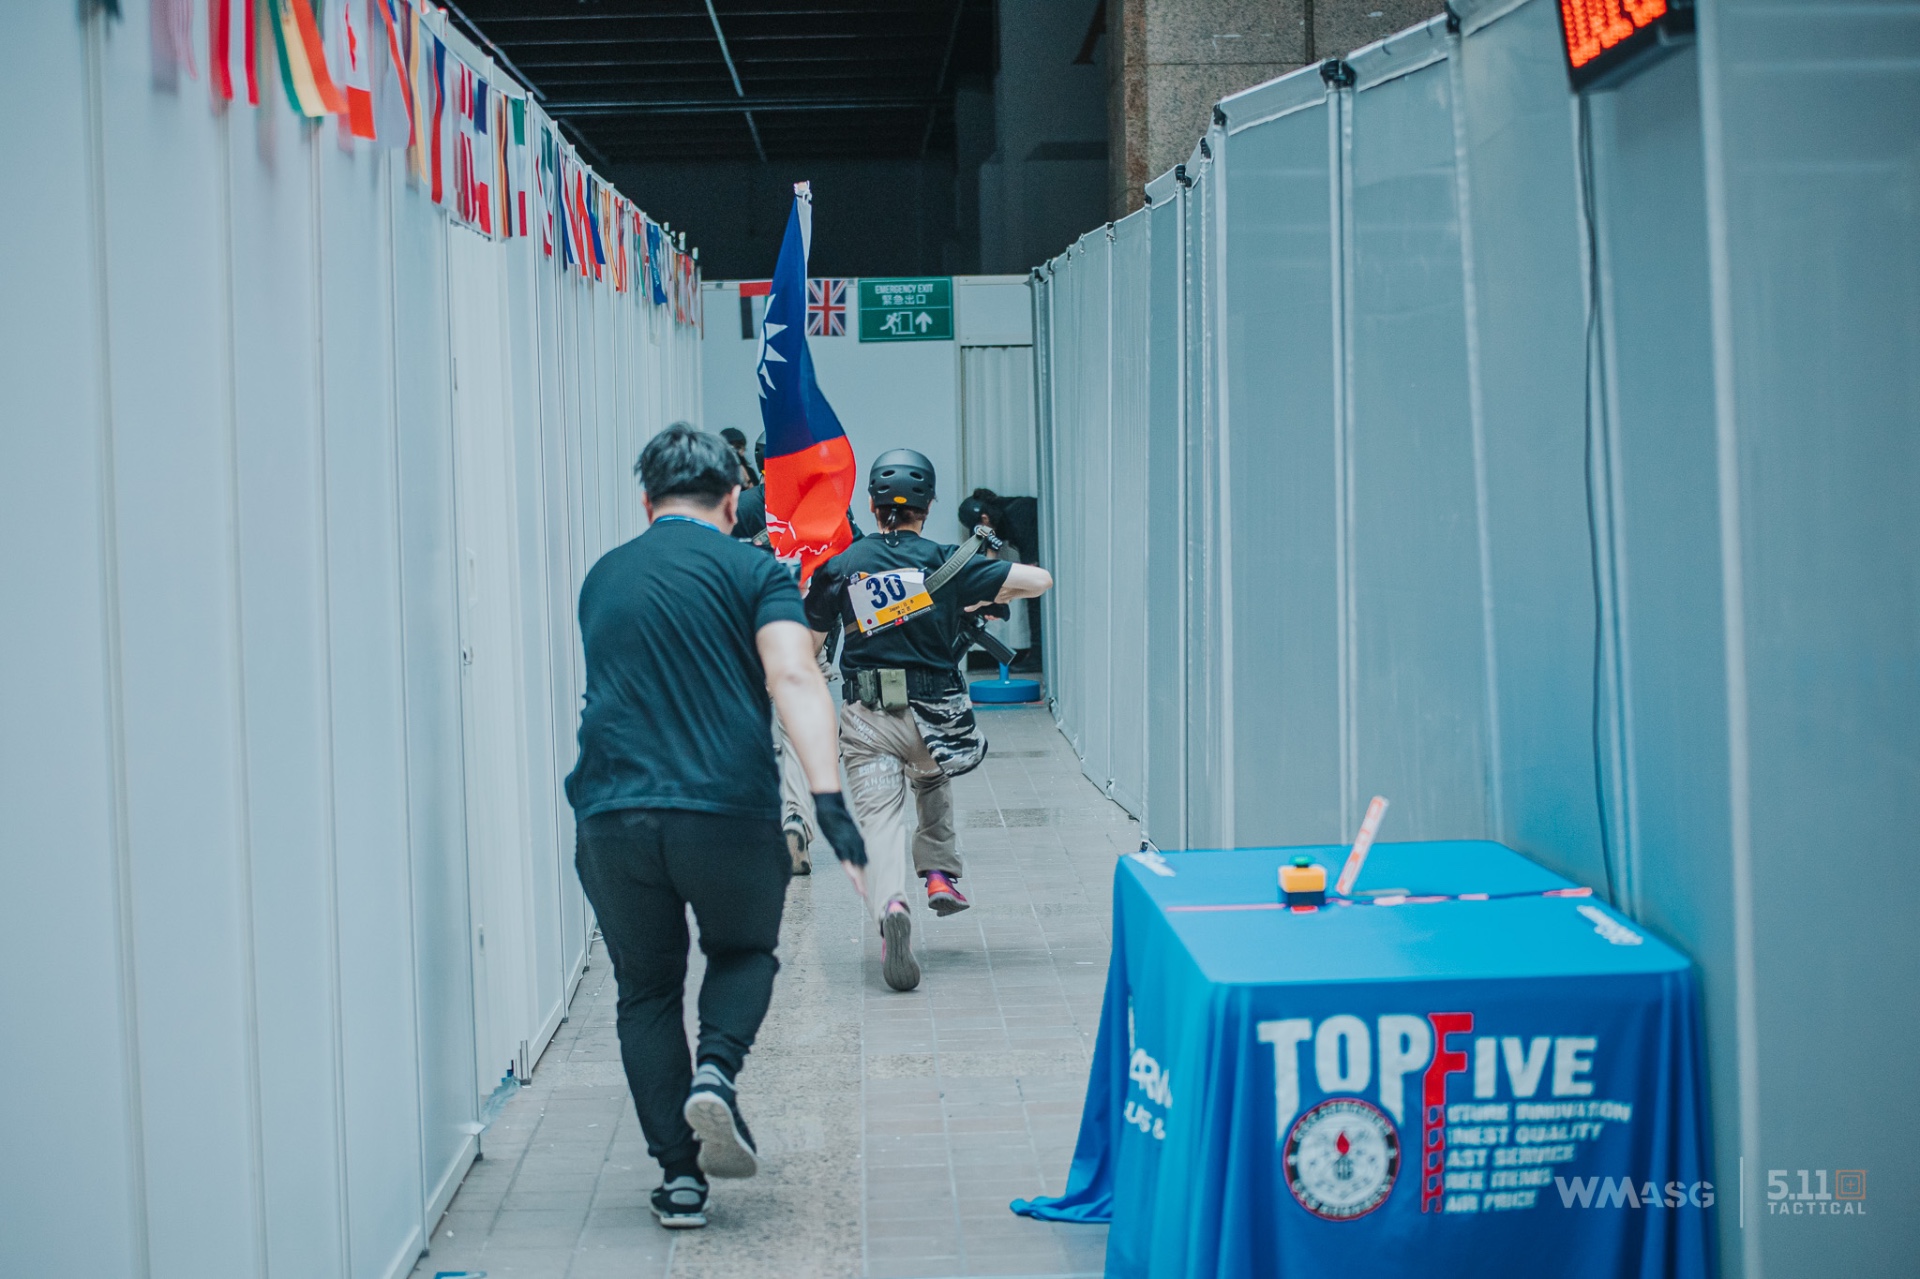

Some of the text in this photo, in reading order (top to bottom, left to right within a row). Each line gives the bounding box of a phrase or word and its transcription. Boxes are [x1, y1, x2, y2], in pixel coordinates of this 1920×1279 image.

[875, 284, 933, 294] EMERGENCY EXIT
[882, 294, 926, 306] 緊急出口
[866, 574, 906, 609] 30
[1515, 1122, 1603, 1143] QUALITY
[1494, 1144, 1575, 1166] SERVICE
